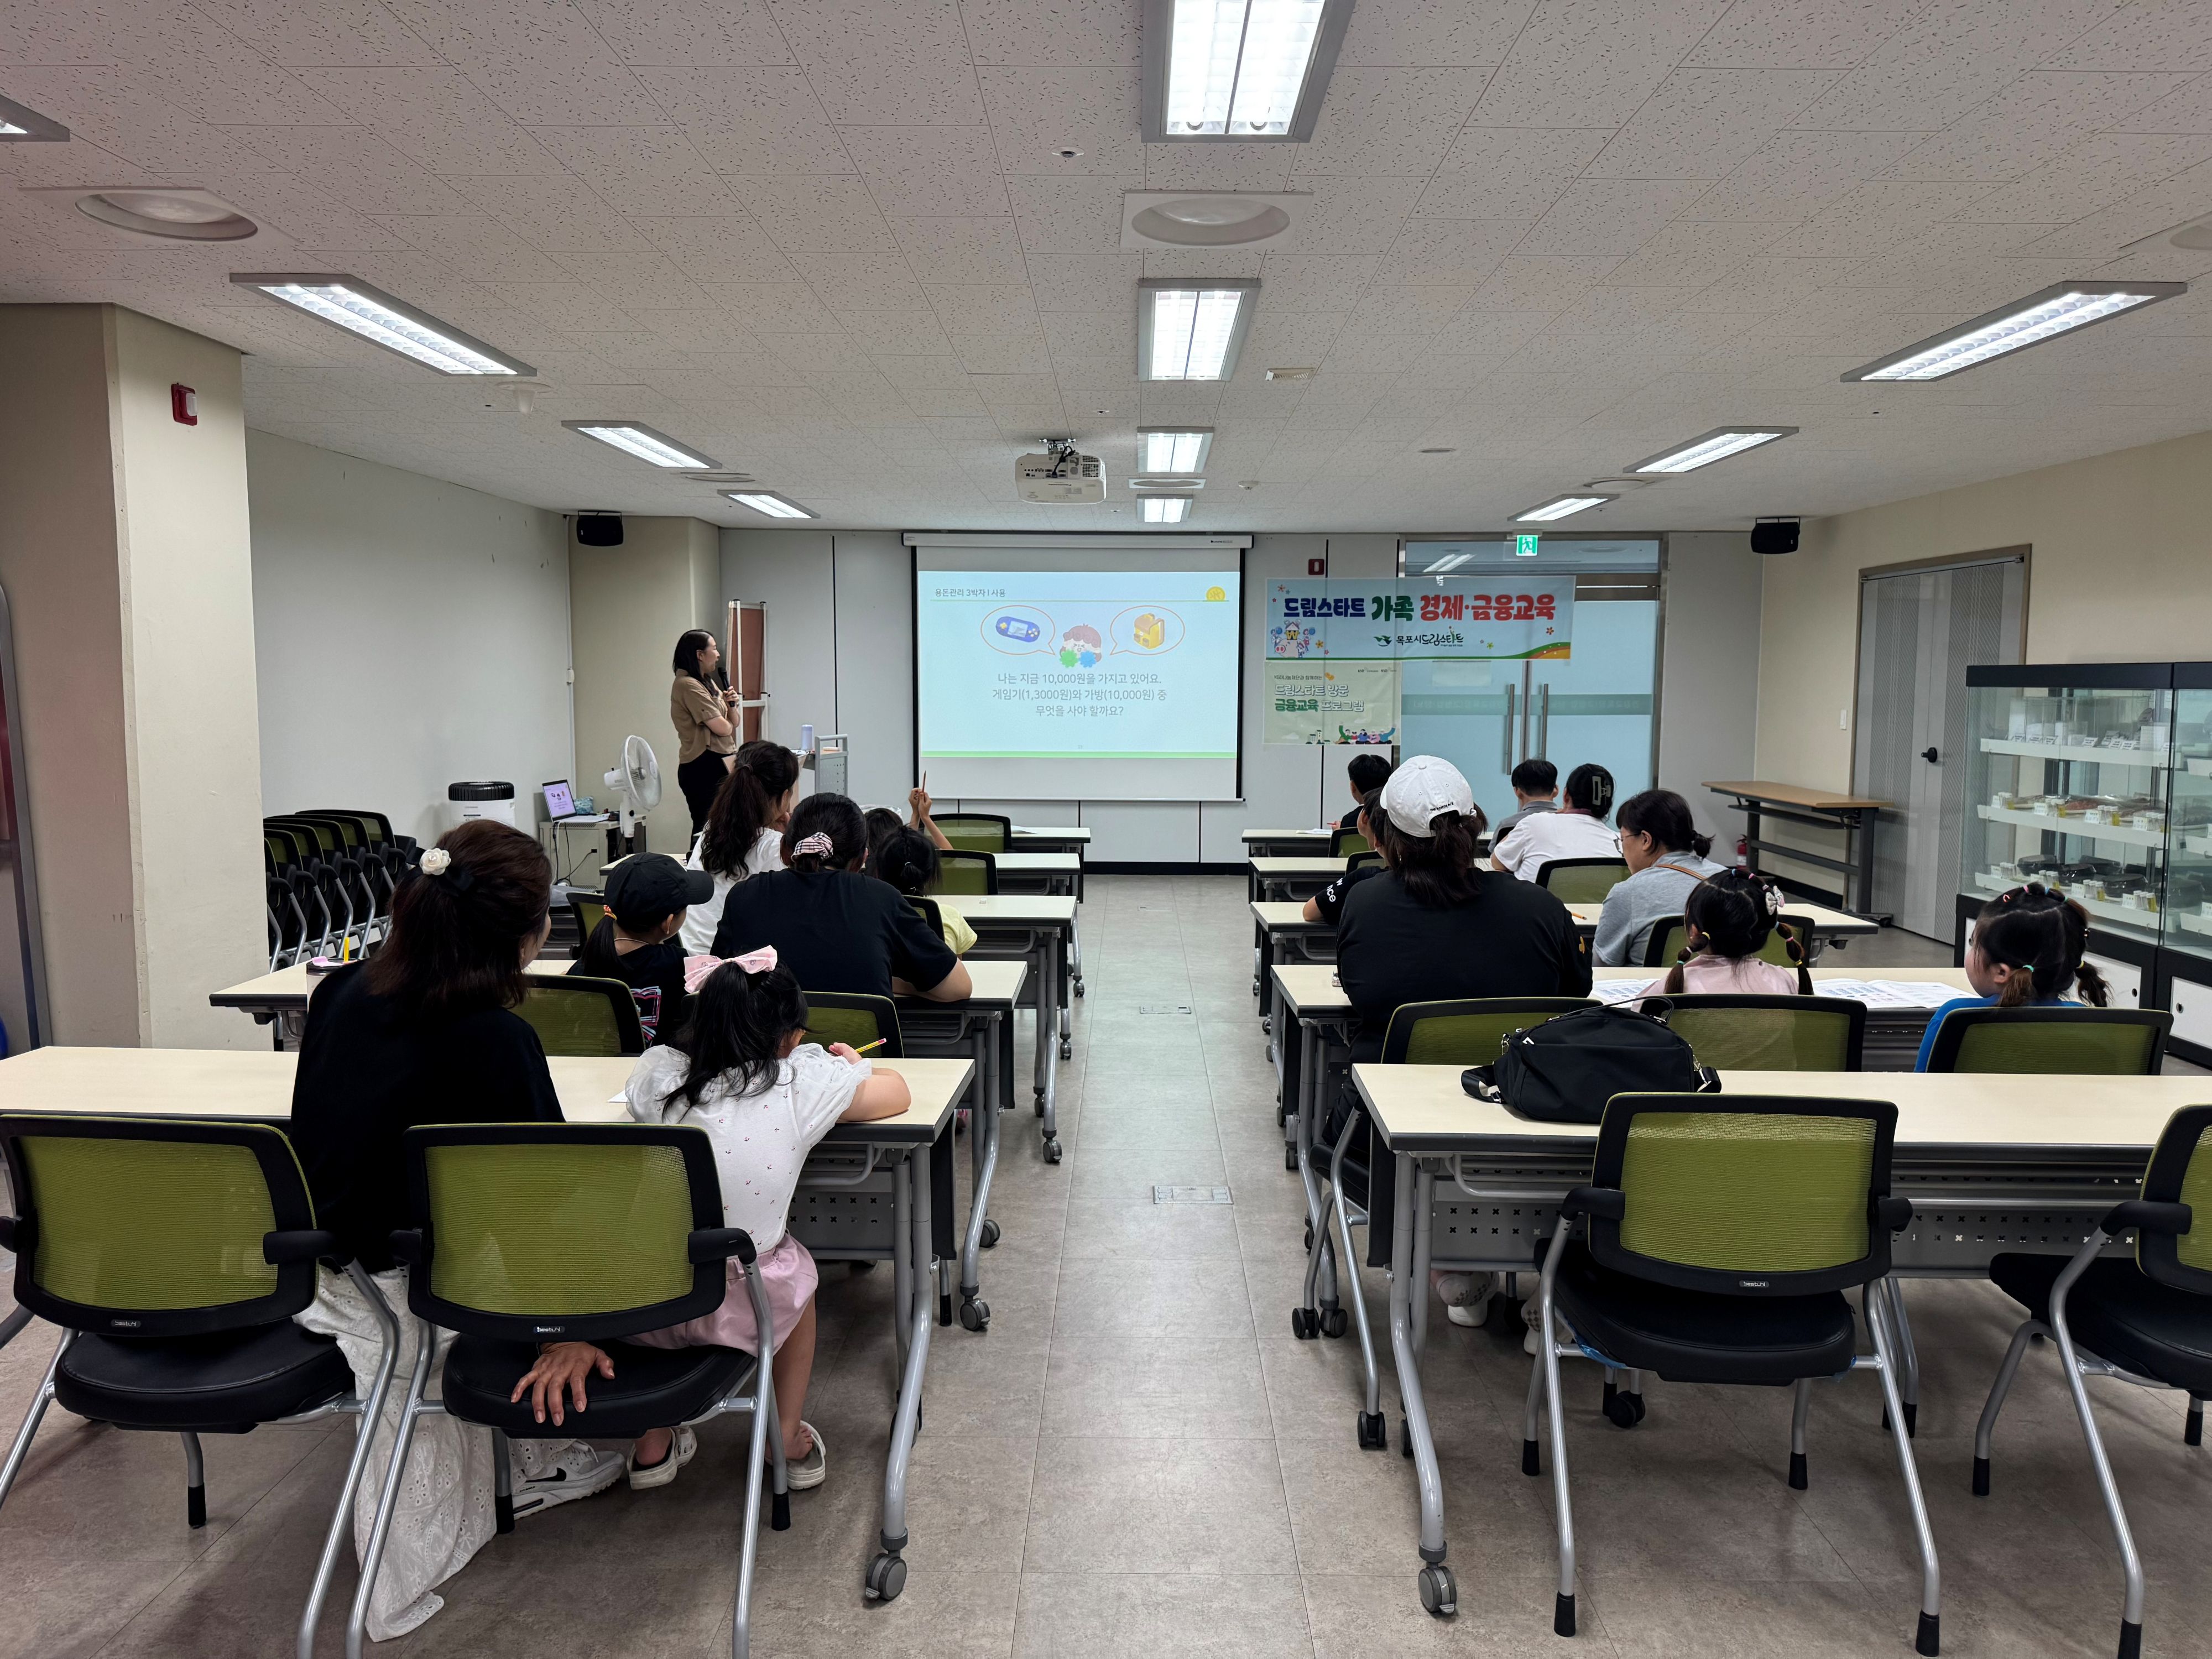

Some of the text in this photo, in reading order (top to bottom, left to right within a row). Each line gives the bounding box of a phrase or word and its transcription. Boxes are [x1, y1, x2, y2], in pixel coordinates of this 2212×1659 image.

[935, 588, 964, 597] 용돈관리
[966, 589, 985, 597] 3박자
[992, 589, 1006, 598] 사용
[1284, 598, 1365, 617] 드림스타트
[1371, 596, 1414, 622] 가족
[998, 673, 1161, 685] 나는 지금 10,000원을 가지고 있어요.
[993, 689, 1167, 701] 게임기(1,3000원)와 가방(10,000원) 중
[1274, 685, 1349, 697] 드림스타트 방문
[1036, 705, 1124, 717] 무엇을 사야 할까요?
[1275, 698, 1364, 712] 금융교육 프로그램
